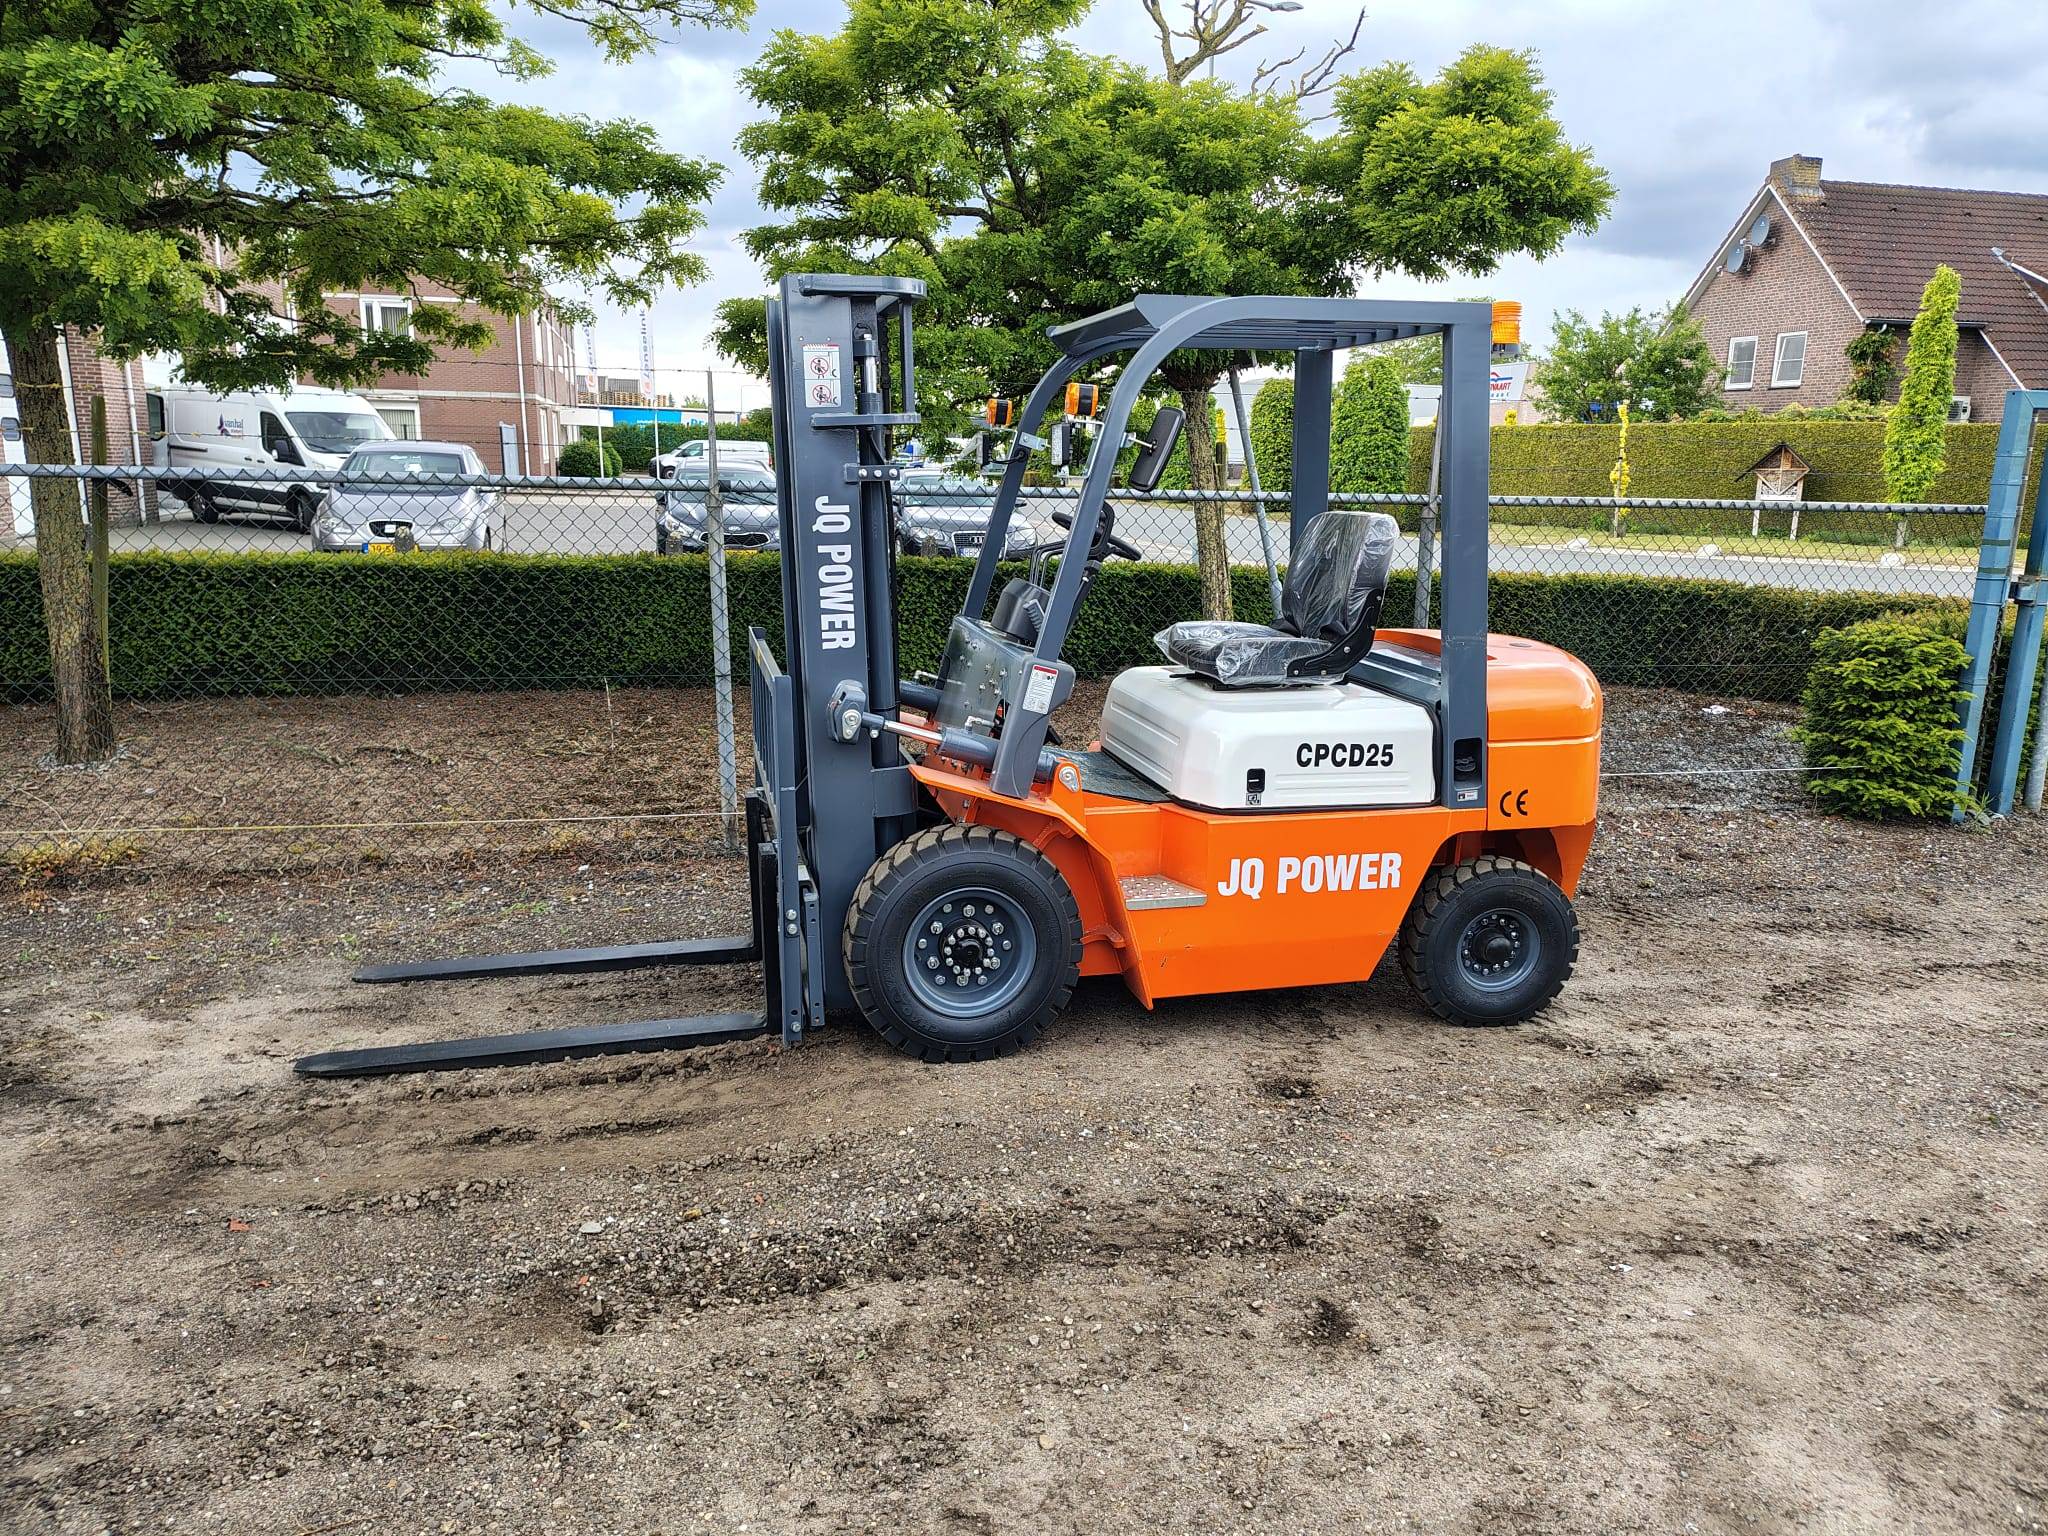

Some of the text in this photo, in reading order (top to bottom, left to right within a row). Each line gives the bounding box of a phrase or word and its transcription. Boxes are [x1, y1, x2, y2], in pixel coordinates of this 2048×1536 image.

[812, 495, 856, 650] JQ POWER
[1296, 742, 1394, 768] CPCD25
[1499, 789, 1529, 818] CE
[1217, 852, 1402, 900] JQ POWER
